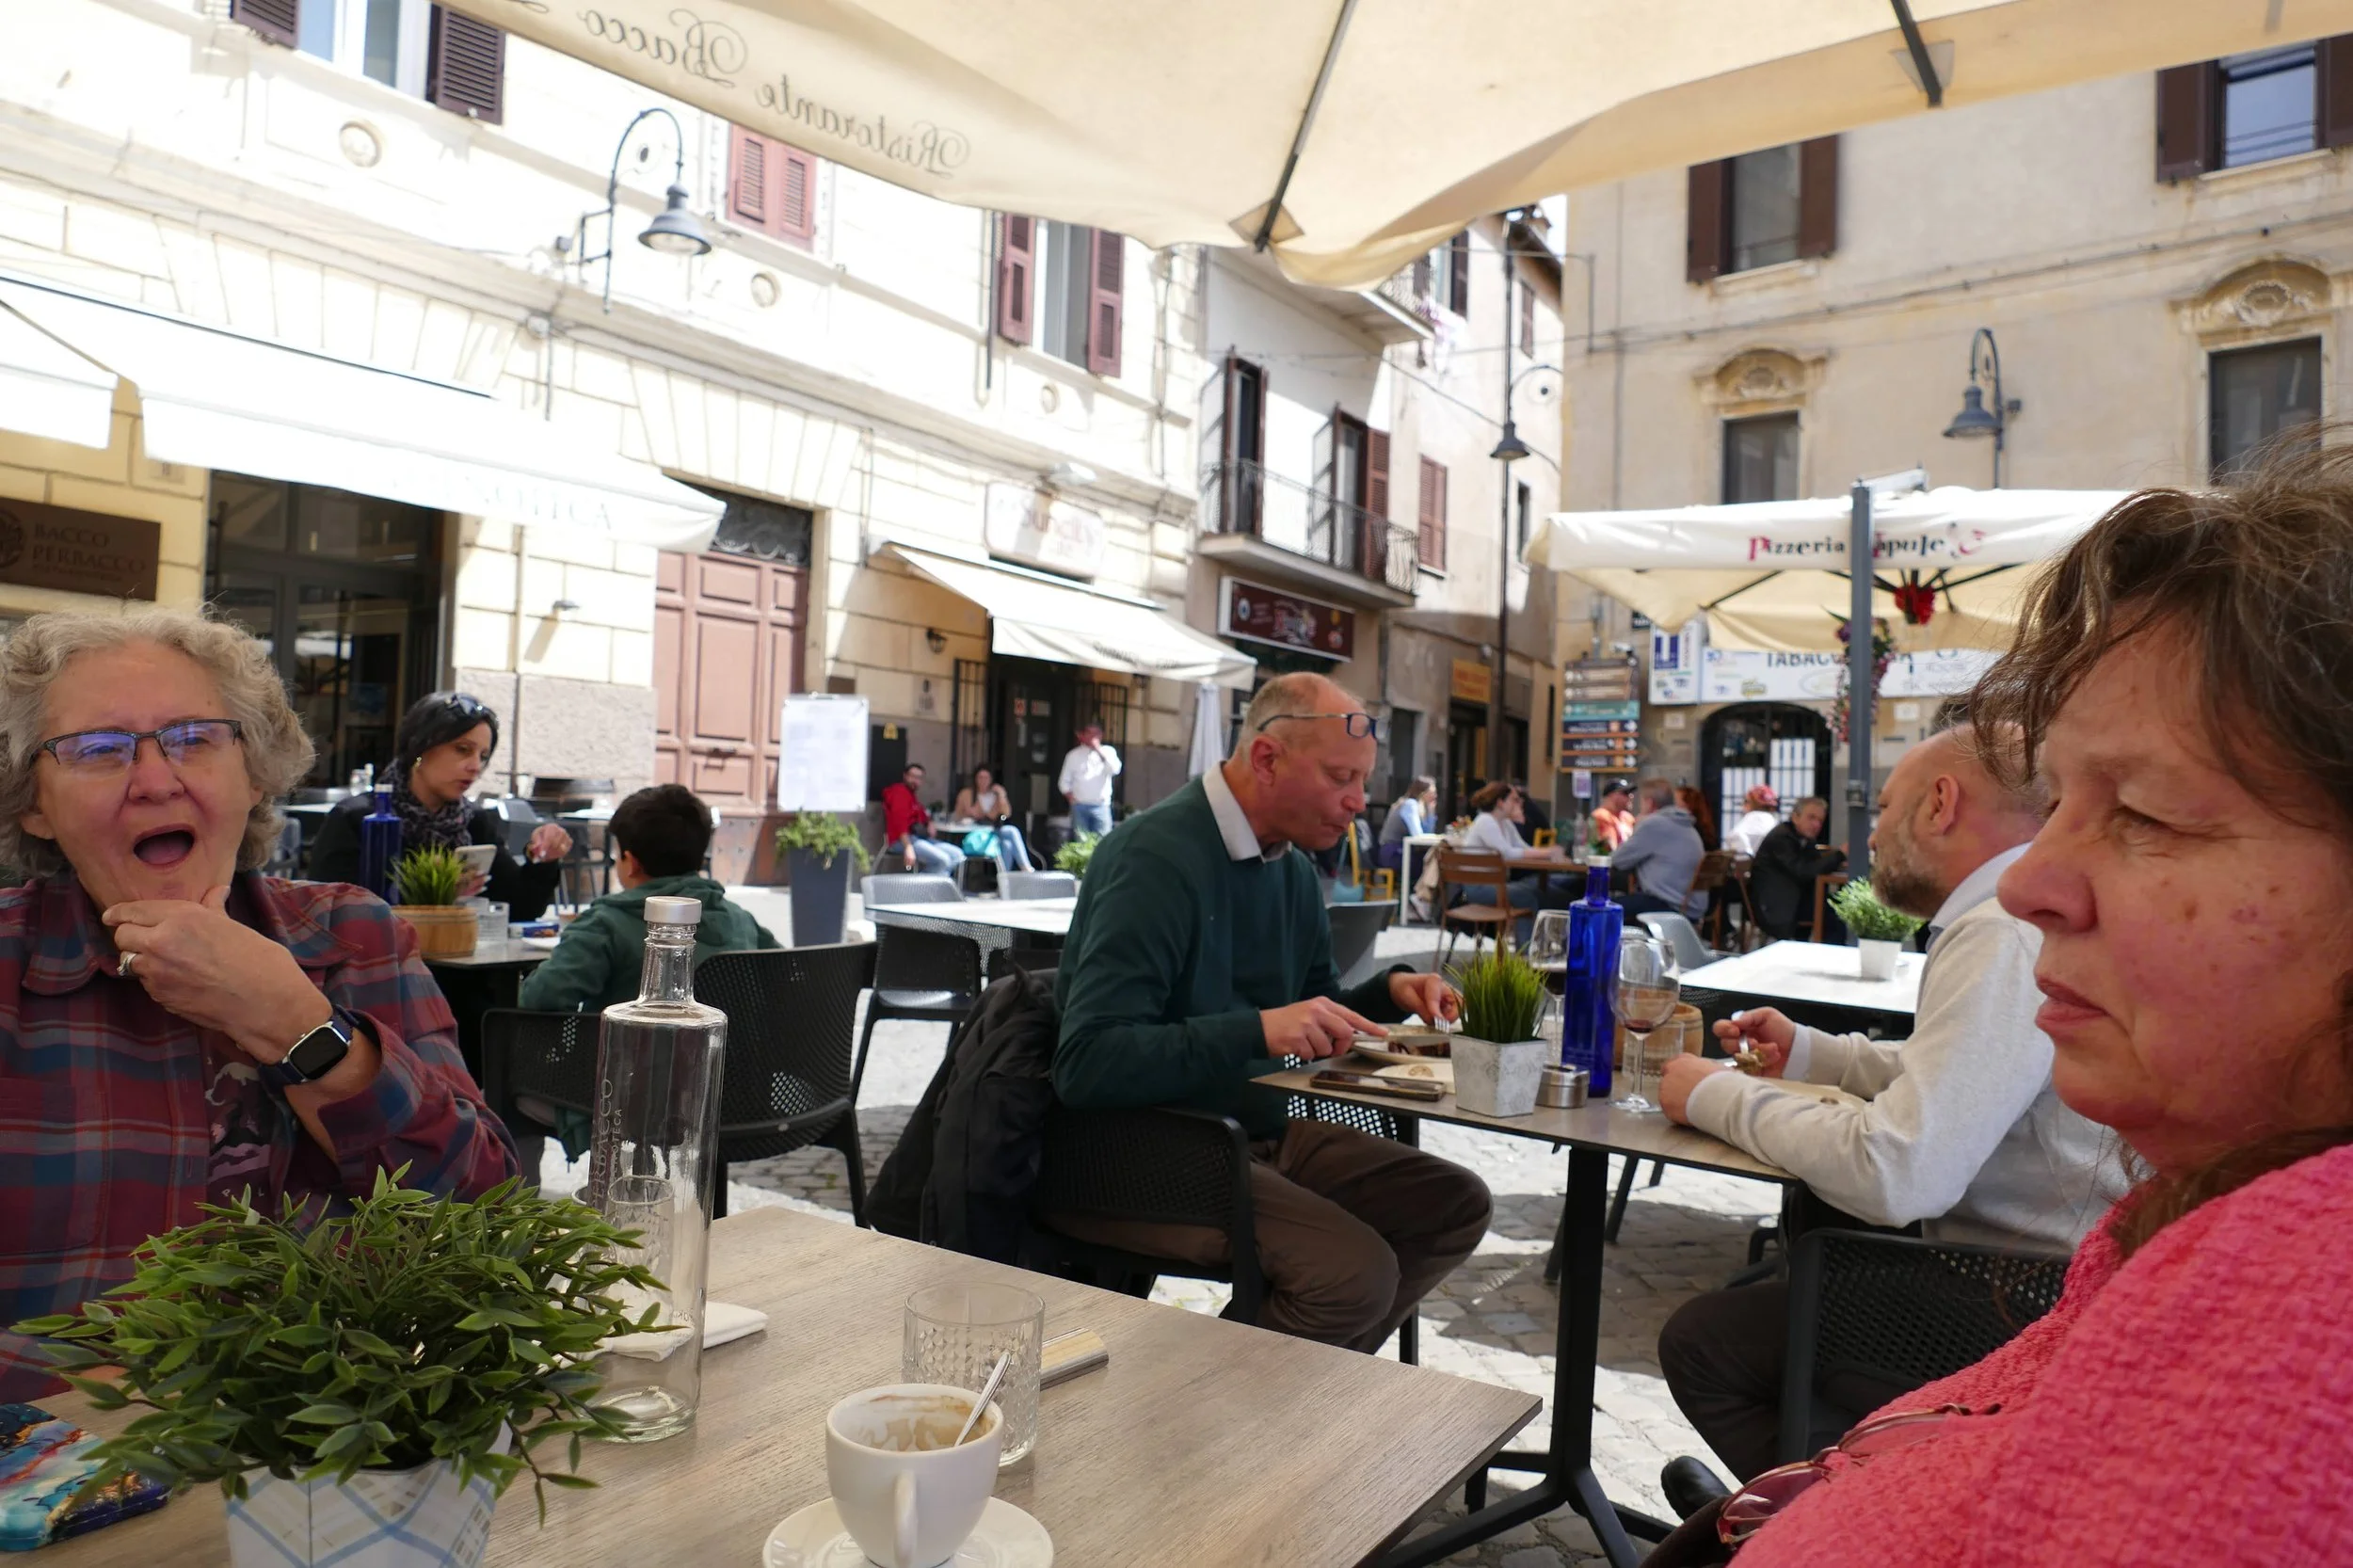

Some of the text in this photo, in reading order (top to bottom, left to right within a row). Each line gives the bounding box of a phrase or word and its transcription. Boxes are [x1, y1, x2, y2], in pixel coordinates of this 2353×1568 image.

[34, 521, 111, 549] BACCO
[1749, 536, 1846, 561] Pizzeria
[32, 543, 148, 574] PERBACCO
